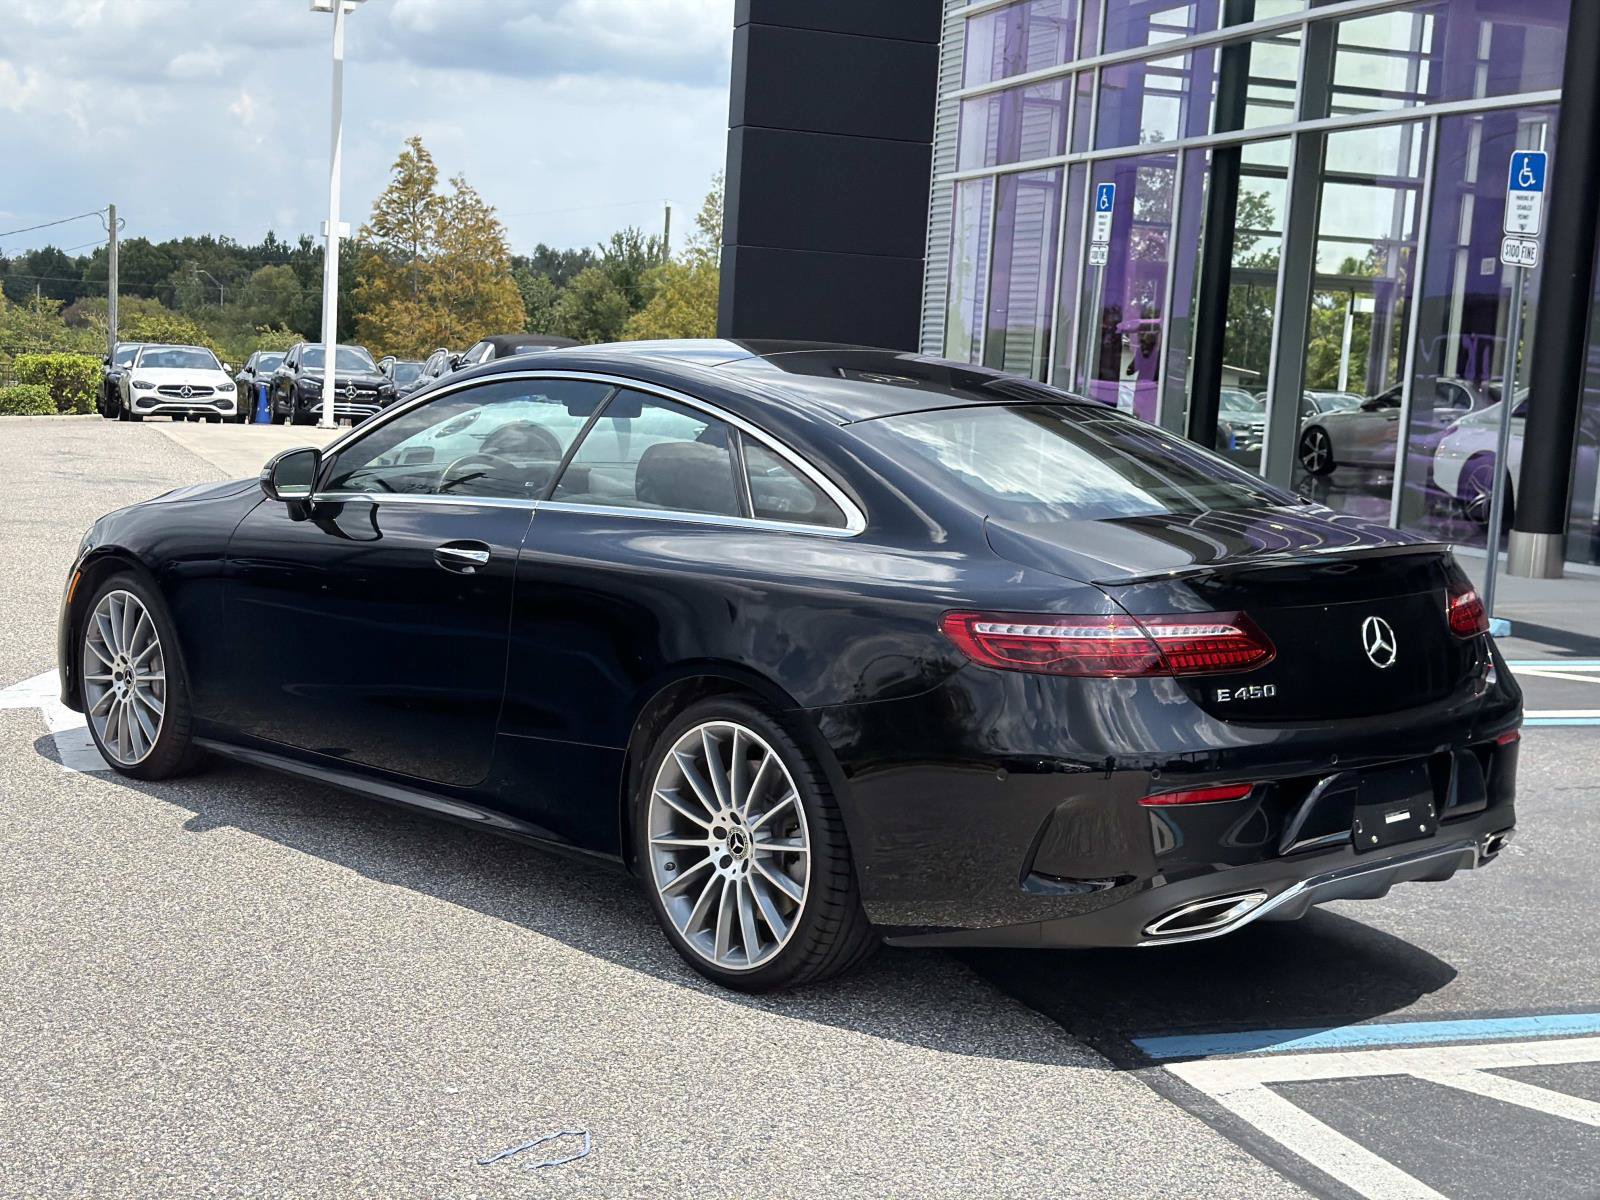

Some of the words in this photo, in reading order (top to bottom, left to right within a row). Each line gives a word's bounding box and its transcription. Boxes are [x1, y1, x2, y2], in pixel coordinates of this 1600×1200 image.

[1505, 244, 1520, 257] $100
[1521, 246, 1535, 260] FINE
[1217, 689, 1231, 702] E
[1234, 684, 1276, 700] 450
